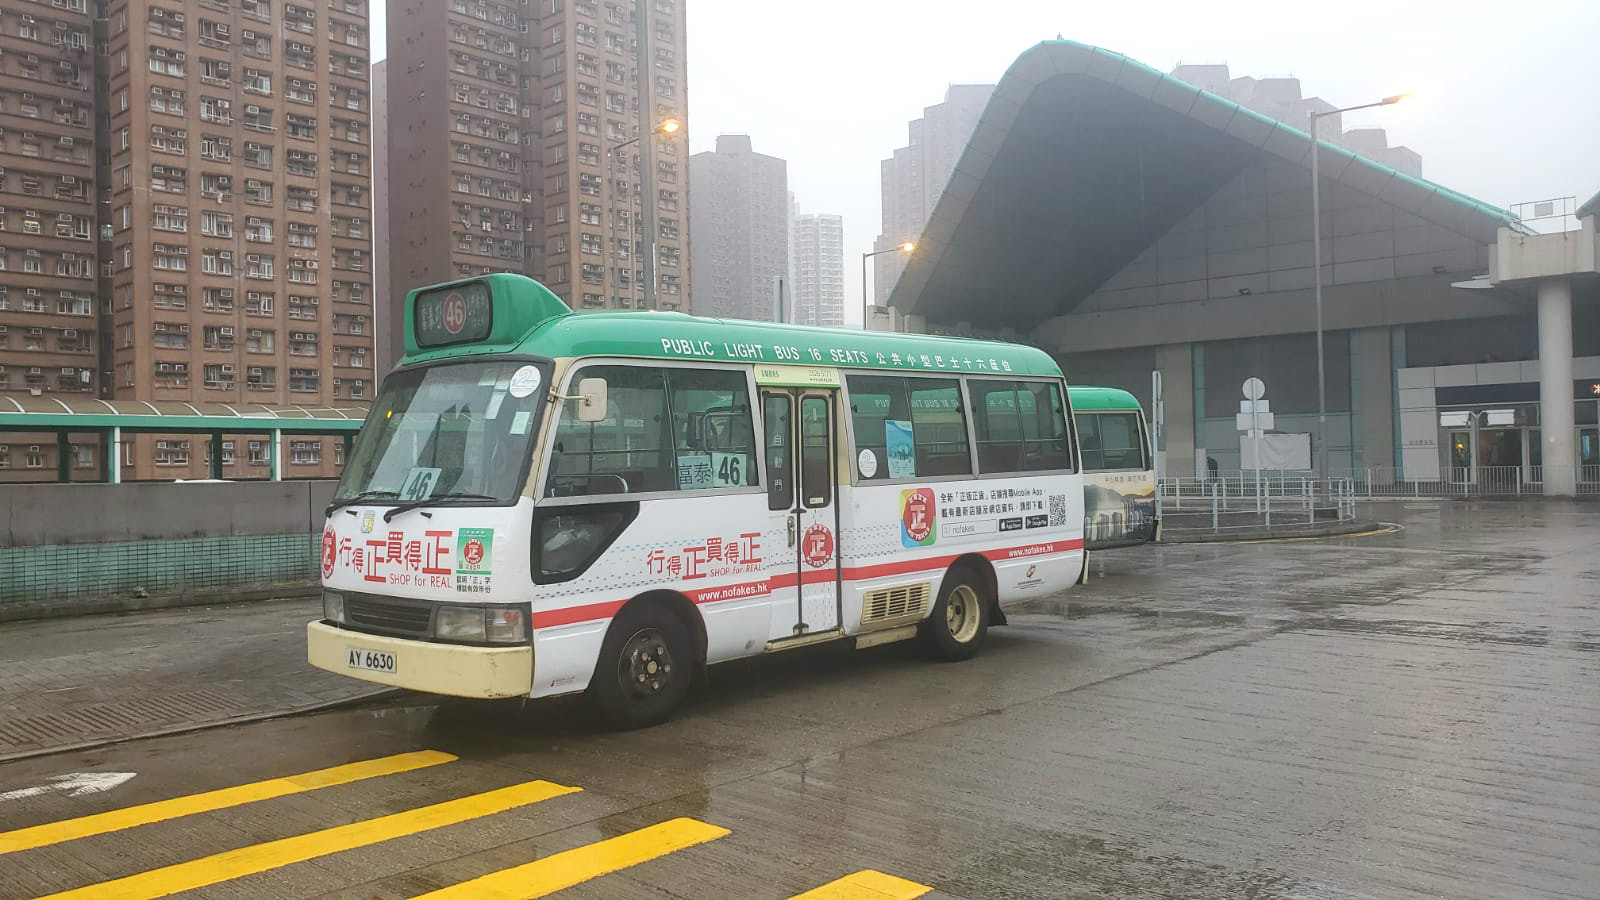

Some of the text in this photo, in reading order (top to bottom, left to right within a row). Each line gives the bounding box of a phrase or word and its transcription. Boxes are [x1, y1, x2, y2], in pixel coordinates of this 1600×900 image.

[447, 300, 463, 326] 46
[661, 338, 715, 356] PUBLIC
[724, 342, 764, 359] LIGHT
[773, 345, 800, 360] BUS
[808, 347, 822, 361] 16
[831, 349, 869, 364] SEATS
[679, 462, 712, 485] 富泰
[718, 456, 741, 486] 46
[406, 471, 431, 500] 46
[910, 504, 926, 530] 正
[339, 530, 453, 583] 行得正買得正
[647, 532, 763, 580] 行得正買得正
[390, 573, 452, 588] SHOP for REAL
[710, 564, 762, 577] SHOP for REAL
[698, 583, 768, 601] www.nofakes.hk
[349, 649, 394, 670] AY 6630
